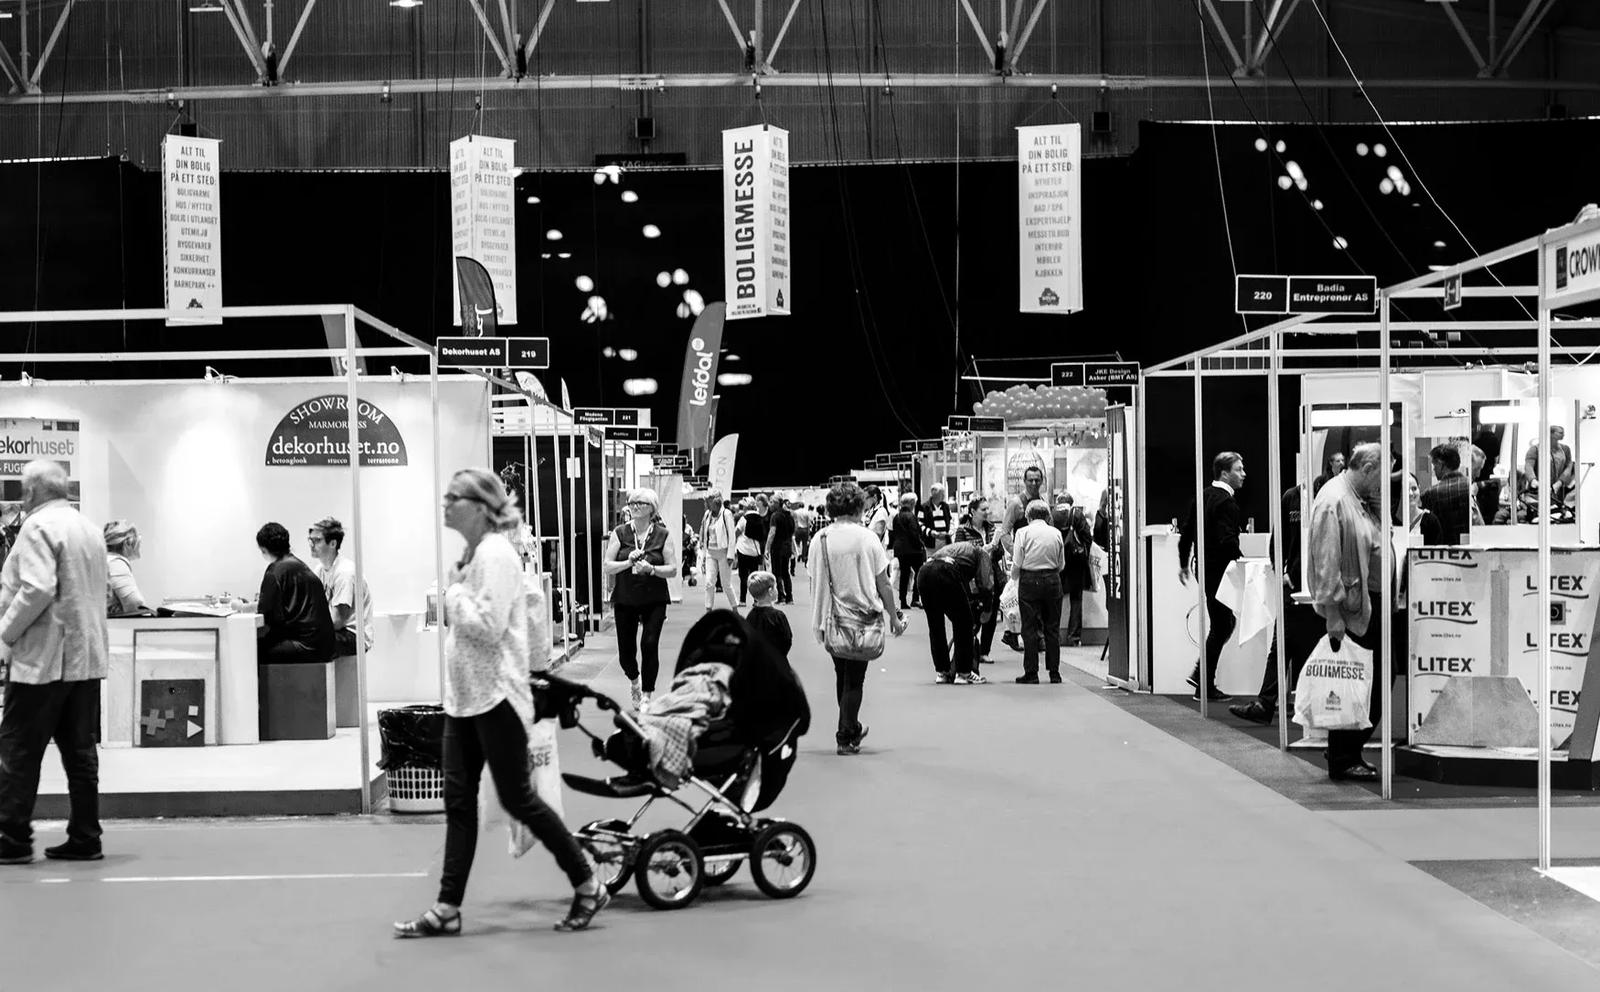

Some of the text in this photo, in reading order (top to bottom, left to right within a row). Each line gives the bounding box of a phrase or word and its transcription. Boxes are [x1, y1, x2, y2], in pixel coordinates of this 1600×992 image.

[1034, 136, 1061, 146] ALT TIL
[181, 146, 205, 158] ALT TIL
[1028, 148, 1068, 160] DIN BOLIG
[176, 160, 210, 172] DIN BOLIG
[1022, 162, 1032, 174] PÅ
[1034, 163, 1048, 173] ETT
[170, 170, 179, 182] PÅ
[182, 173, 194, 184] ETT
[734, 139, 756, 300] BOLIGMESSE
[1316, 284, 1345, 292] Badia
[1254, 292, 1272, 300] 220
[442, 348, 500, 356] Dekorhuset AS
[1110, 368, 1131, 376] Design
[690, 351, 714, 406] lefdal
[308, 420, 367, 430] MARMORSS
[1526, 575, 1584, 591] LTEX
[1418, 601, 1473, 616] LITEX
[1526, 632, 1584, 649] LTEX
[1418, 657, 1473, 672] LITEX
[1550, 690, 1582, 706] TEX
